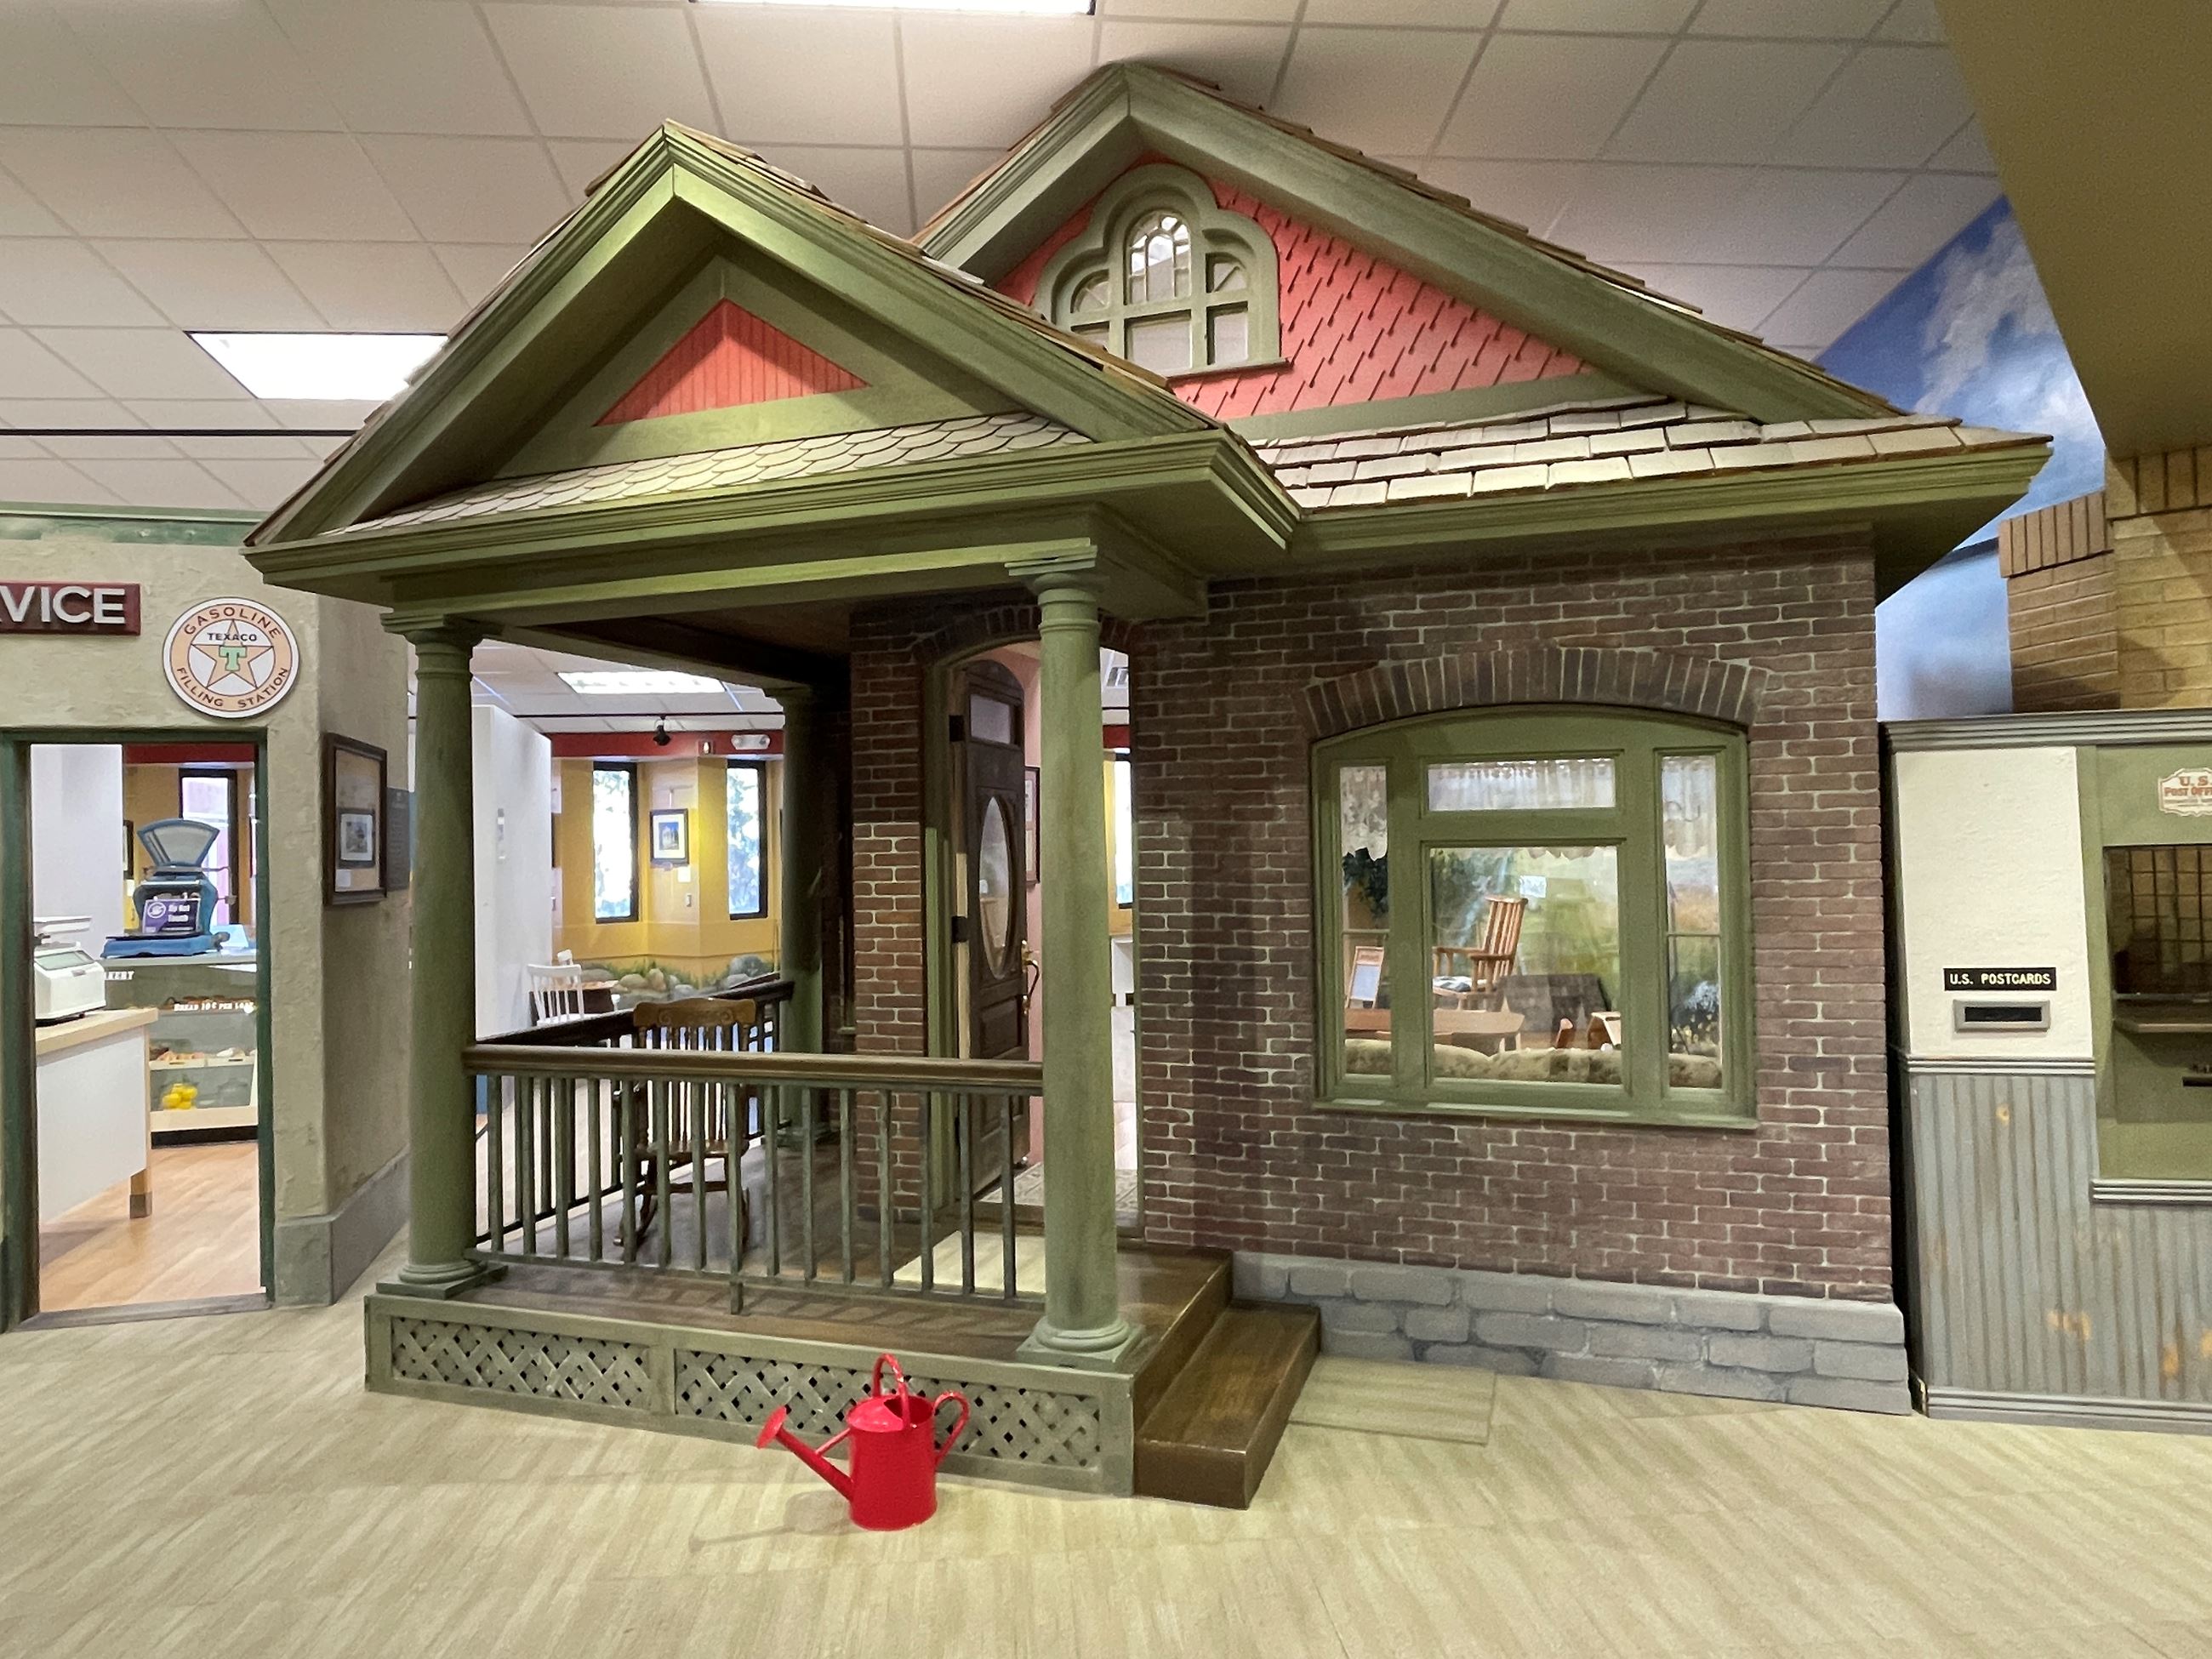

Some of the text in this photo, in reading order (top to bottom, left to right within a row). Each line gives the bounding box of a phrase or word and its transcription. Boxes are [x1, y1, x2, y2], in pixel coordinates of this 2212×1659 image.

[0, 585, 125, 624] VICE
[184, 607, 281, 638] GASOLINE
[207, 632, 257, 641] TEXACO
[219, 646, 248, 672] T
[176, 667, 288, 708] FILLING STATION
[2164, 787, 2188, 797] POST
[1949, 972, 2051, 985] U.S. POSTCARDS
